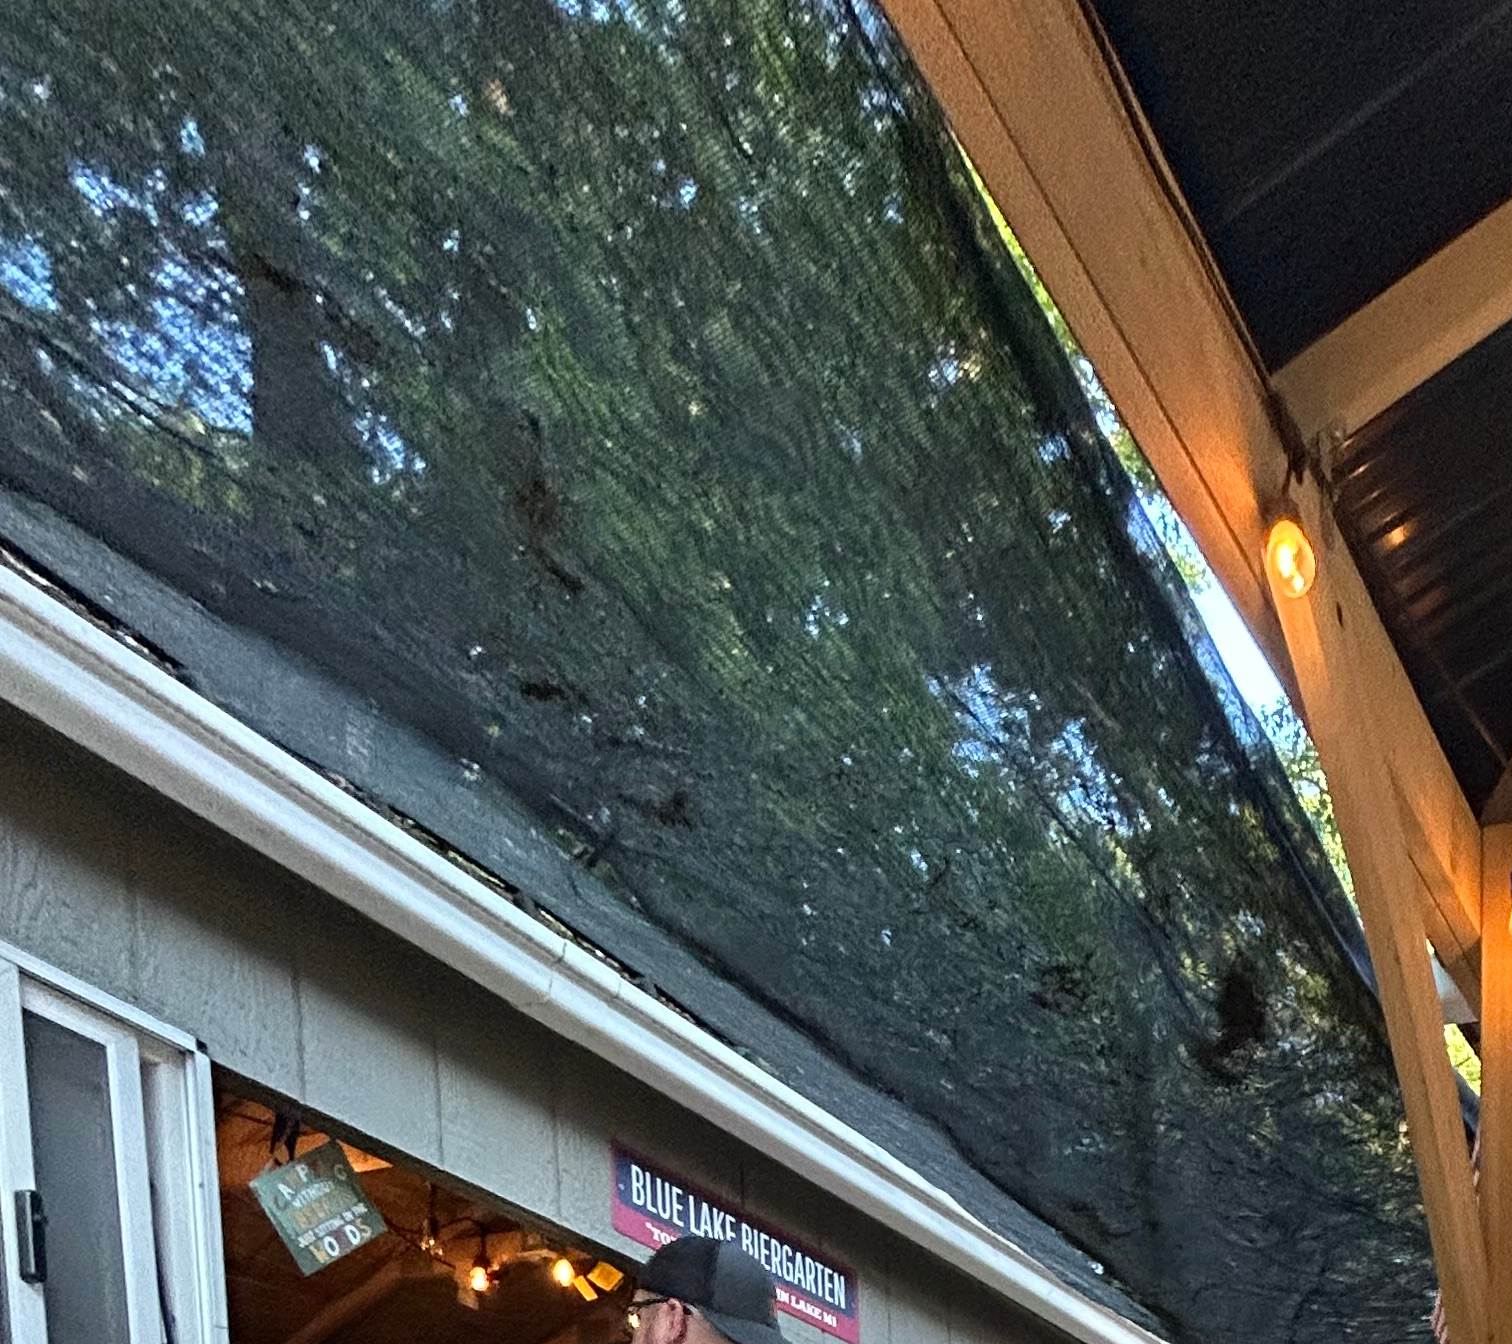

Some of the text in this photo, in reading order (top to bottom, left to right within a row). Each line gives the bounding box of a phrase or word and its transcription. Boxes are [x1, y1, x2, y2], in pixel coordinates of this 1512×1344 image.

[631, 1164, 846, 1310] BLUE LAKE BIERGARTEN
[791, 1295, 822, 1320] LAKE
[823, 1312, 837, 1327] MI
